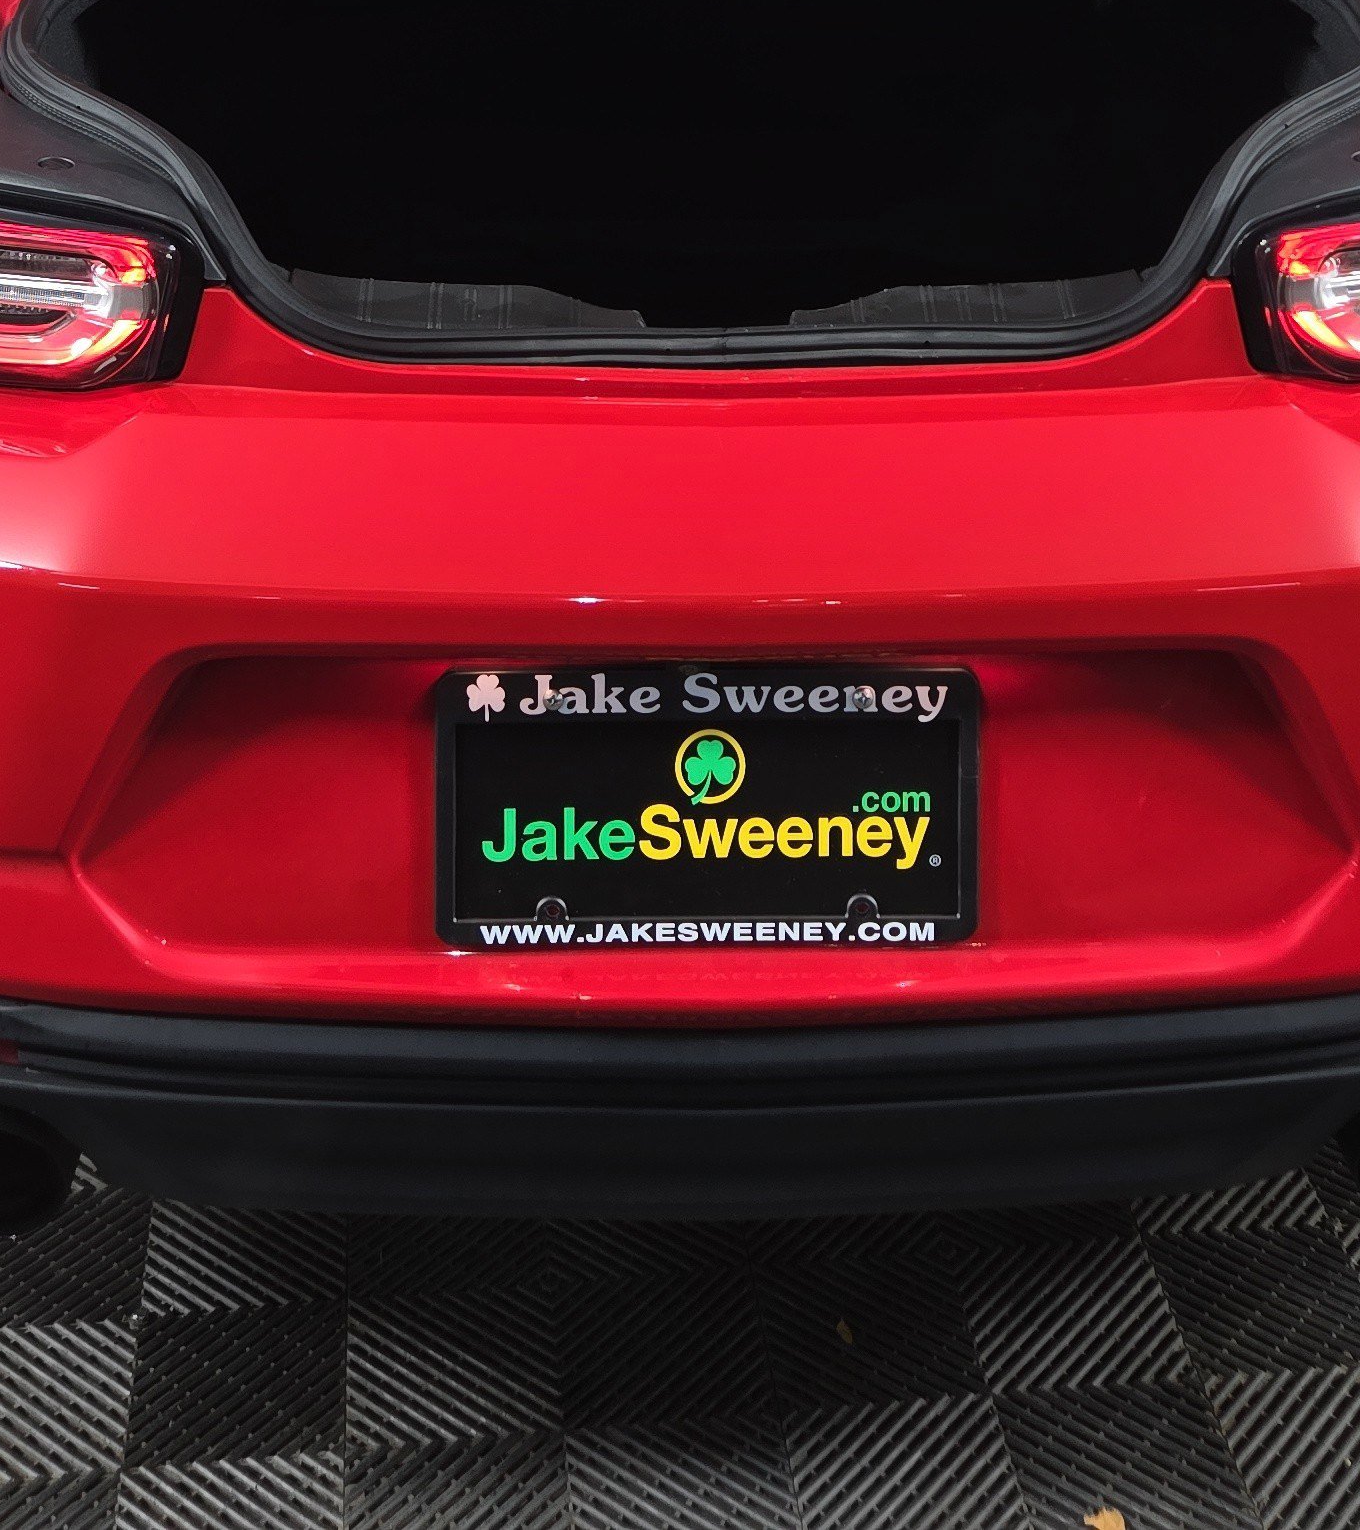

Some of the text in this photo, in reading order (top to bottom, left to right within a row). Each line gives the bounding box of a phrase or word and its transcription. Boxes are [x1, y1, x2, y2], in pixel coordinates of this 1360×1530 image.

[519, 673, 949, 723] Jake Sweeney
[481, 804, 931, 870] JakeSweeney
[480, 921, 936, 945] WWW.JAKESWEENEY.COM
